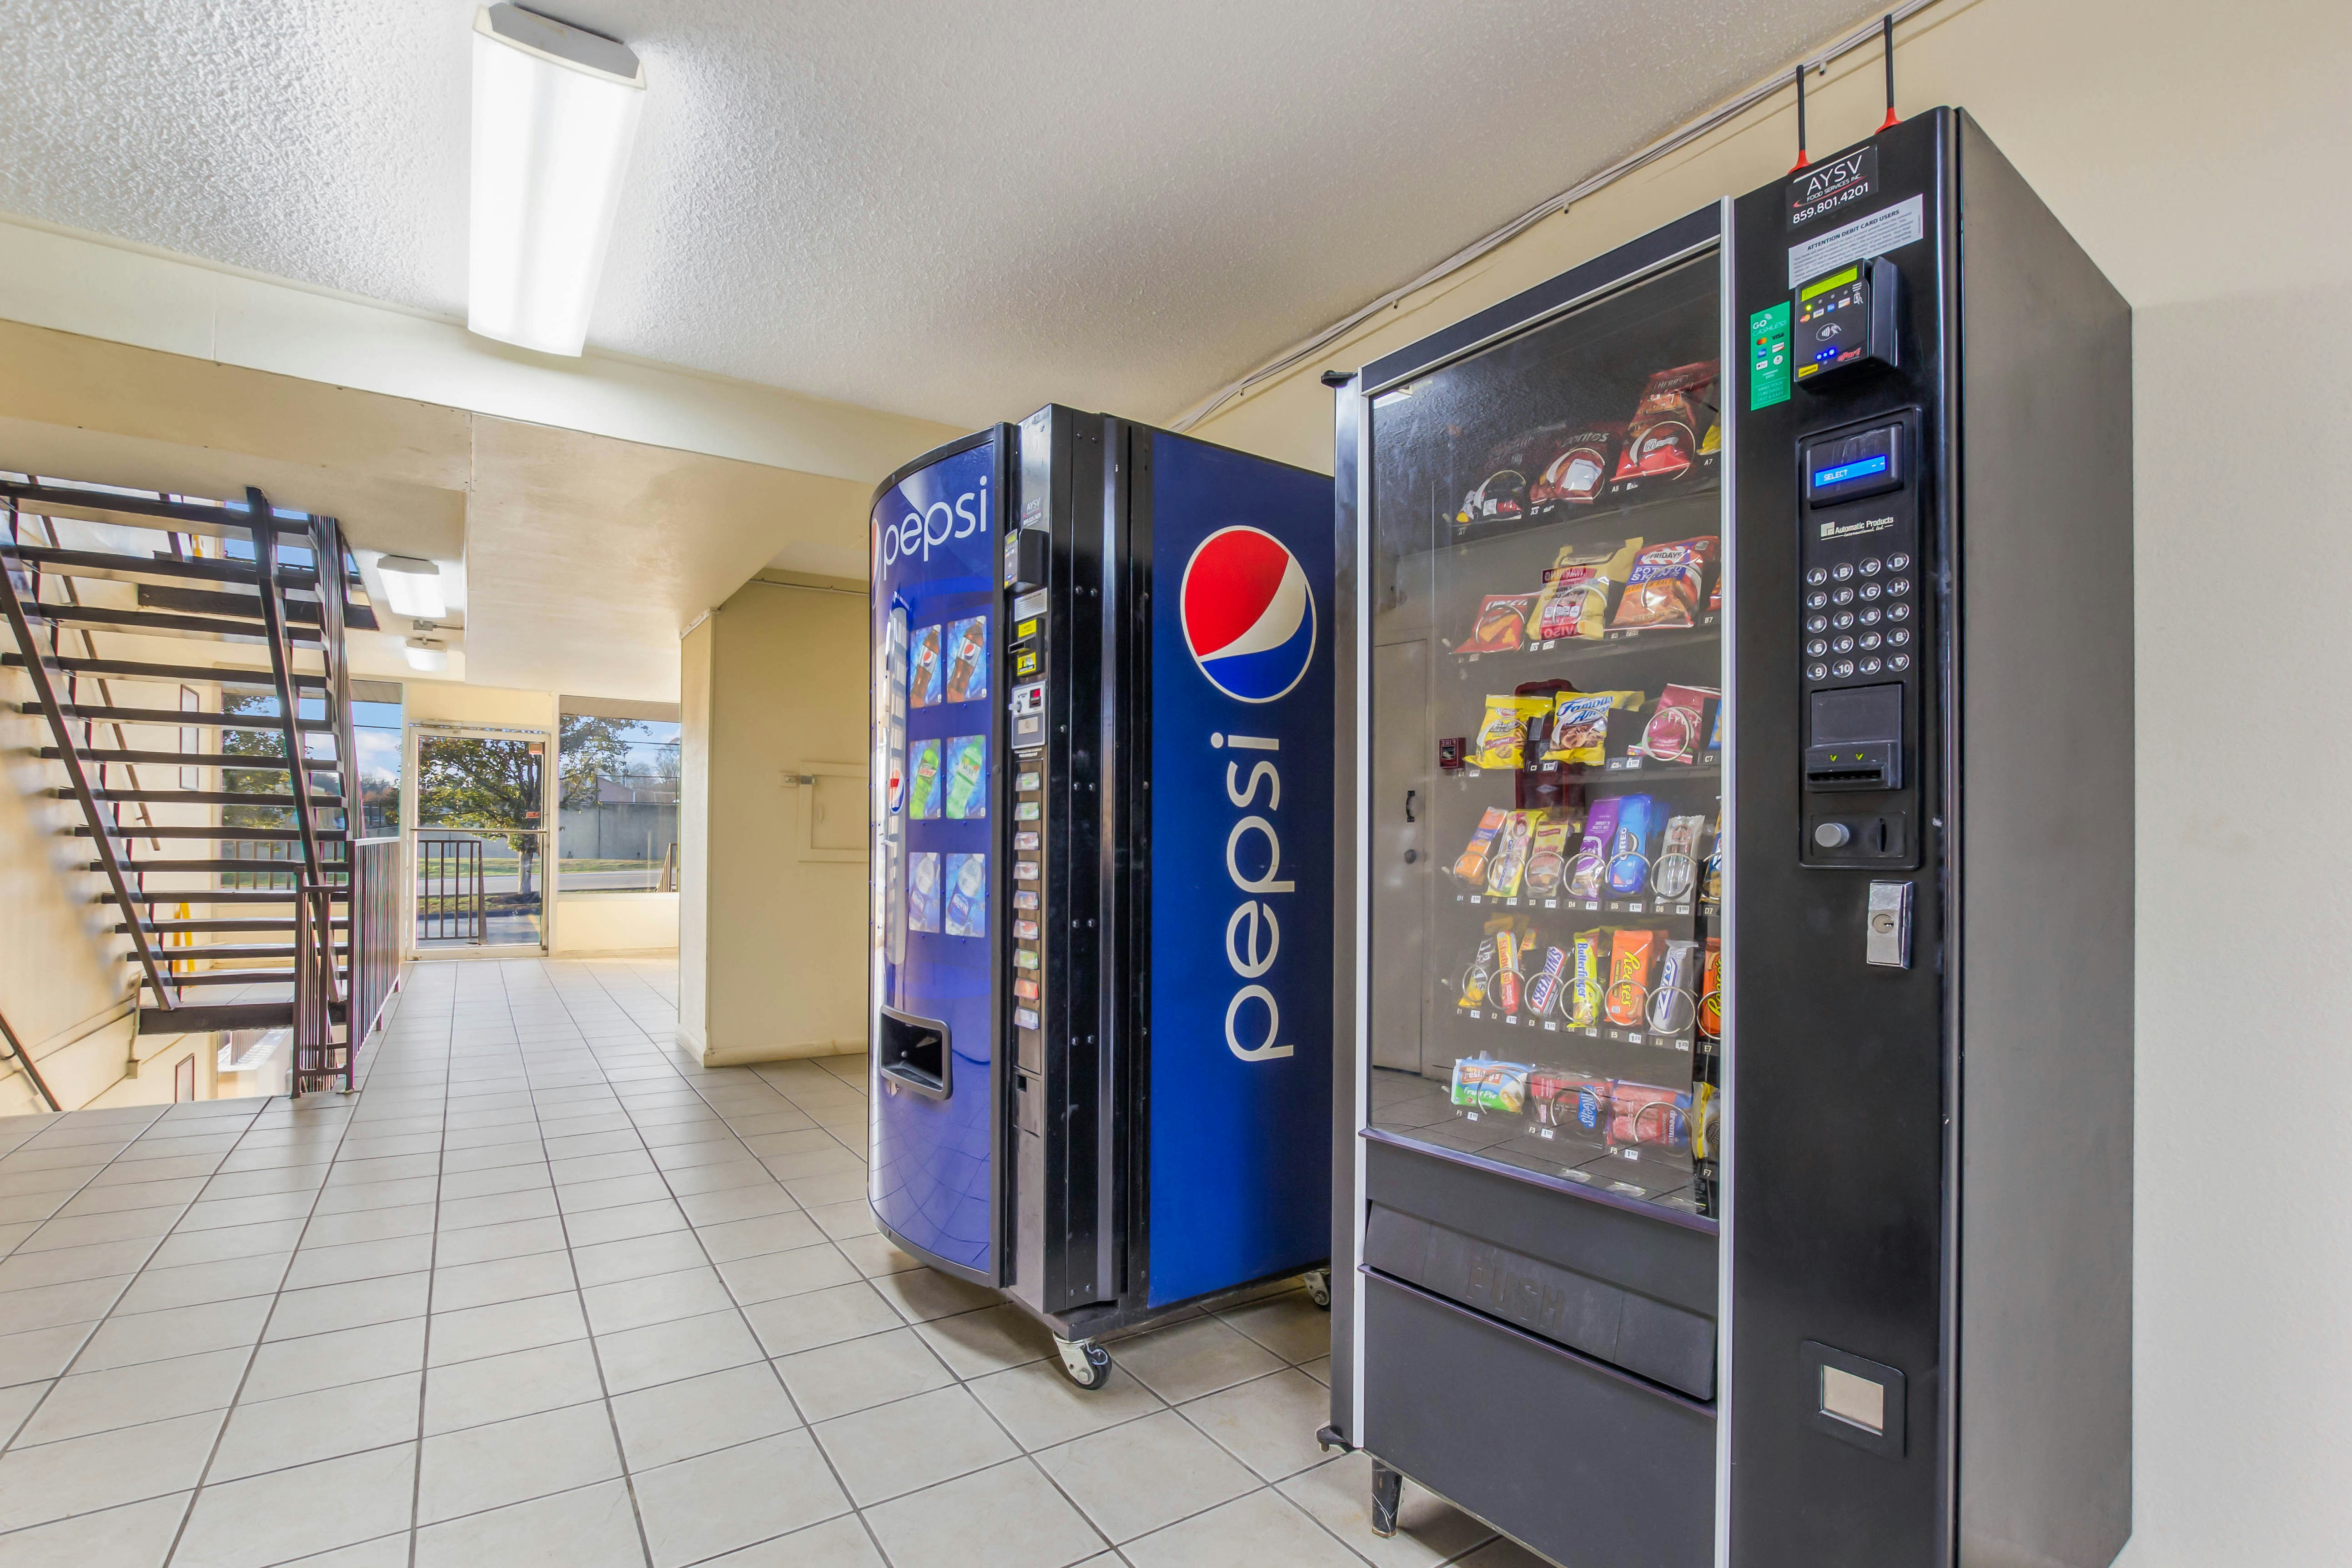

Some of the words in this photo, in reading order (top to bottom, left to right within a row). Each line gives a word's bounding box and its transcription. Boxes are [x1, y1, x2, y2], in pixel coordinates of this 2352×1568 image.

[1807, 155, 1863, 196] AYSV
[1807, 190, 1823, 202] FOOD
[1824, 178, 1850, 194] SERVICES
[1793, 182, 1869, 224] 859.801.4201
[1807, 233, 1840, 251] ATTENTION
[1842, 226, 1859, 237] DEBIT
[1860, 218, 1878, 229] CARD
[1879, 209, 1900, 221] USERS
[1753, 319, 1767, 330] GO
[1753, 319, 1788, 337] CASHLESS
[1772, 332, 1784, 340] VISA
[1823, 469, 1848, 482] SELECT
[1026, 497, 1040, 512] AYSV
[884, 475, 987, 581] pepsi
[1835, 522, 1865, 534] Automatic
[1866, 517, 1894, 528] Products
[1631, 572, 1680, 581] SKINS
[1814, 573, 1822, 583] A
[1839, 568, 1849, 578] B
[1866, 562, 1876, 572] C
[1894, 557, 1904, 568] D
[1814, 596, 1823, 606] E
[1840, 591, 1849, 601] F
[1866, 586, 1877, 597] G
[1895, 582, 1904, 592] H
[1841, 616, 1849, 625] 2
[1895, 607, 1904, 616] 4
[1841, 640, 1850, 649] 6
[1895, 632, 1904, 642] 8
[1814, 667, 1822, 677] 9
[1839, 663, 1850, 674] 10
[1556, 696, 1613, 716] Famous
[1619, 828, 1628, 861] OREO
[1211, 732, 1295, 1063] pepsi
[1576, 942, 1588, 998] Butterfinger
[1483, 1091, 1497, 1099] Pie
